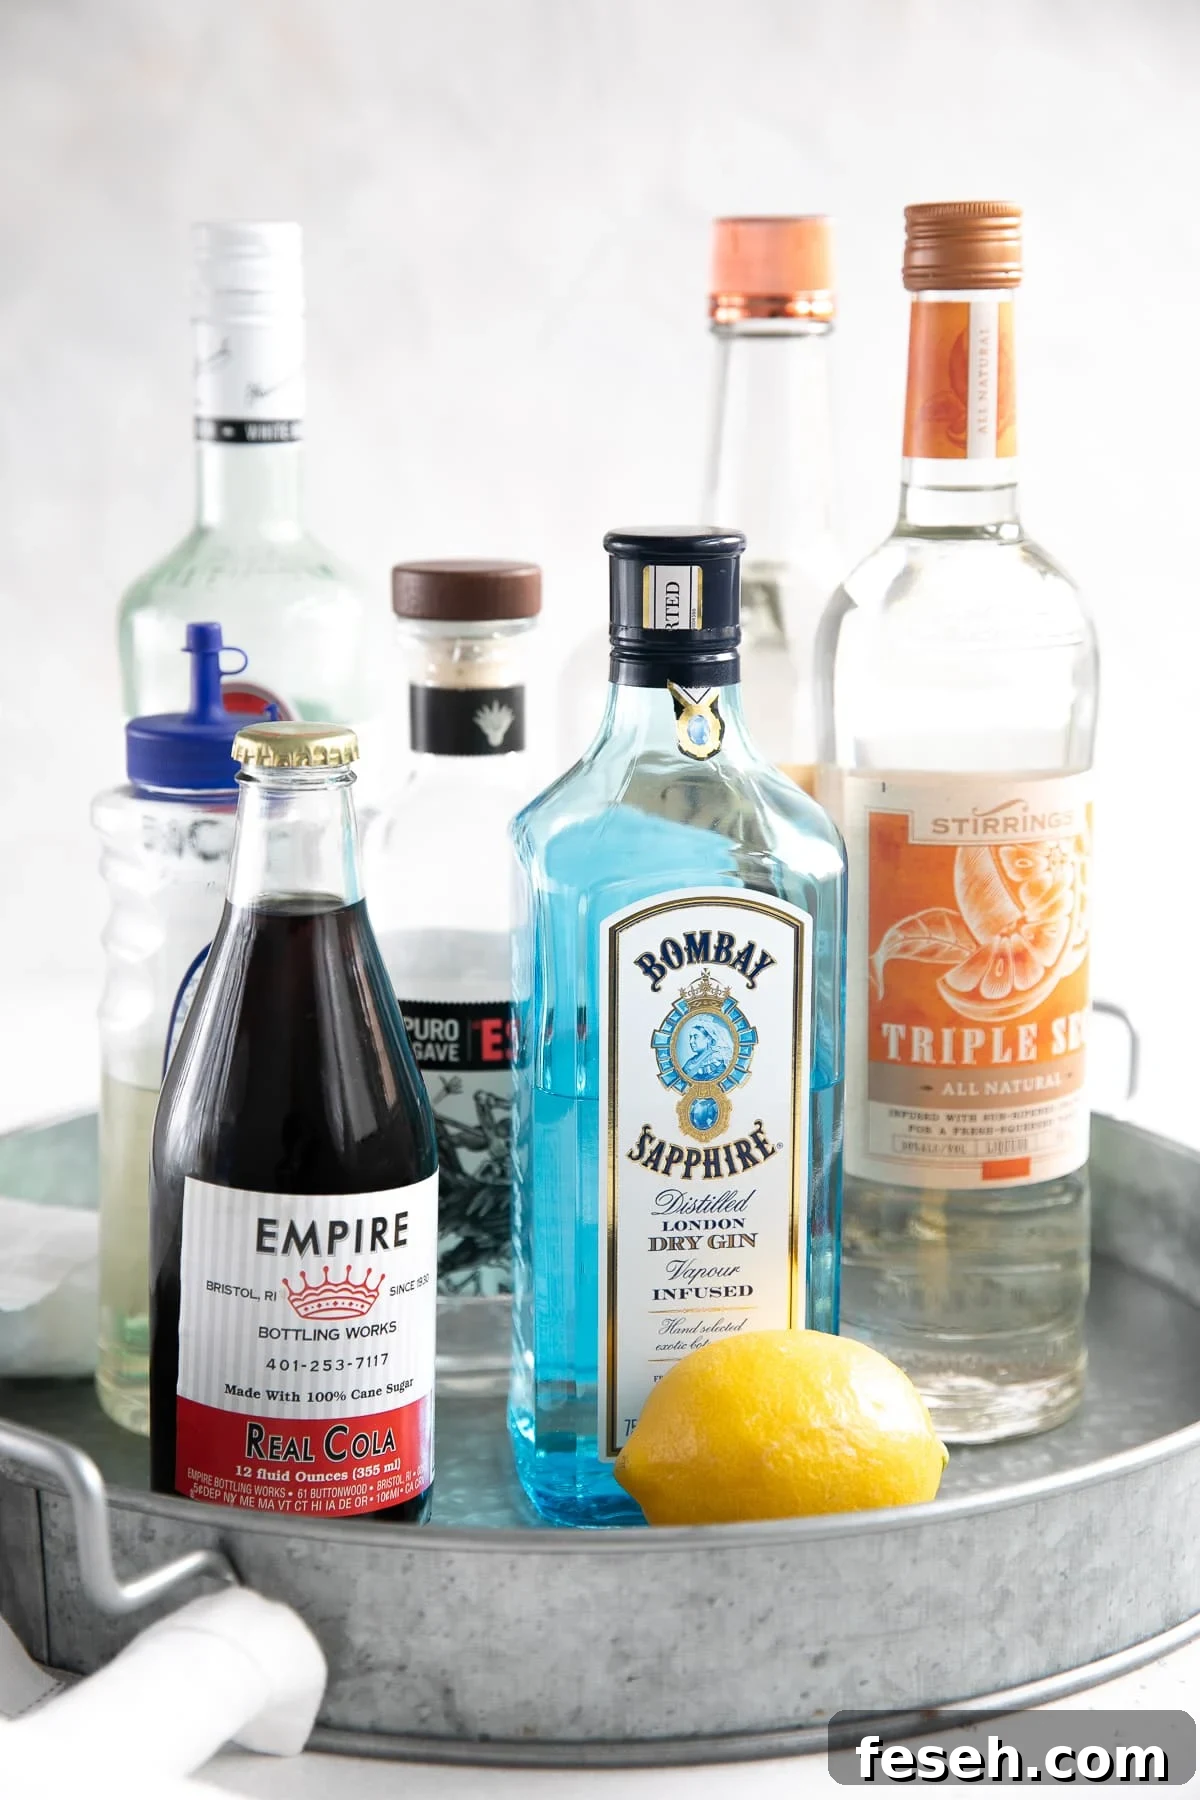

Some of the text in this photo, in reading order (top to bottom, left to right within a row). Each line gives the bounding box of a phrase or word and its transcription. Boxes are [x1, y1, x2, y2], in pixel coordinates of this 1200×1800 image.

[932, 808, 1074, 835] STIRRINGS
[633, 930, 777, 992] BOMBAY
[404, 1017, 460, 1042] PURO
[881, 1023, 1038, 1065] TRIPLE
[941, 1072, 1062, 1097] ALL NATURAL
[626, 1119, 777, 1181] SAPPHIRE
[651, 1188, 757, 1216] Distilled
[256, 1211, 409, 1258] EMPIRE
[662, 1217, 745, 1232] LONDON
[648, 1232, 759, 1252] DRY GIN
[665, 1258, 741, 1285] Vapour
[206, 1280, 260, 1302] BRISTOL,
[264, 1291, 277, 1302] RI
[389, 1280, 415, 1297] SINCE
[651, 1284, 754, 1301] INFUSED
[258, 1321, 398, 1342] BOTTLING WORKS
[658, 1317, 749, 1335] Hand selected
[655, 1335, 710, 1351] exotic bot
[266, 1353, 389, 1373] 401-253-7117
[224, 1378, 414, 1403] Made With 100% Cane Sugar
[245, 1421, 397, 1463] REAL COLA
[235, 1457, 401, 1483] 12 fluid Ounces (355 ml)
[187, 1467, 213, 1487] EMPIRE
[214, 1475, 252, 1496] BOTTLING
[254, 1484, 286, 1498] WORKS
[297, 1488, 308, 1499] 61
[310, 1484, 367, 1499] BUTTONWOOD
[405, 1470, 412, 1481] RI
[223, 1491, 237, 1504] NY
[240, 1495, 255, 1507] ME
[258, 1499, 275, 1511] MA
[277, 1500, 292, 1511] VT
[294, 1500, 309, 1512] CT
[311, 1501, 321, 1511] HI
[325, 1500, 336, 1511] IA
[339, 1498, 352, 1510] DE
[355, 1496, 368, 1508] OR
[405, 1482, 414, 1495] CA
